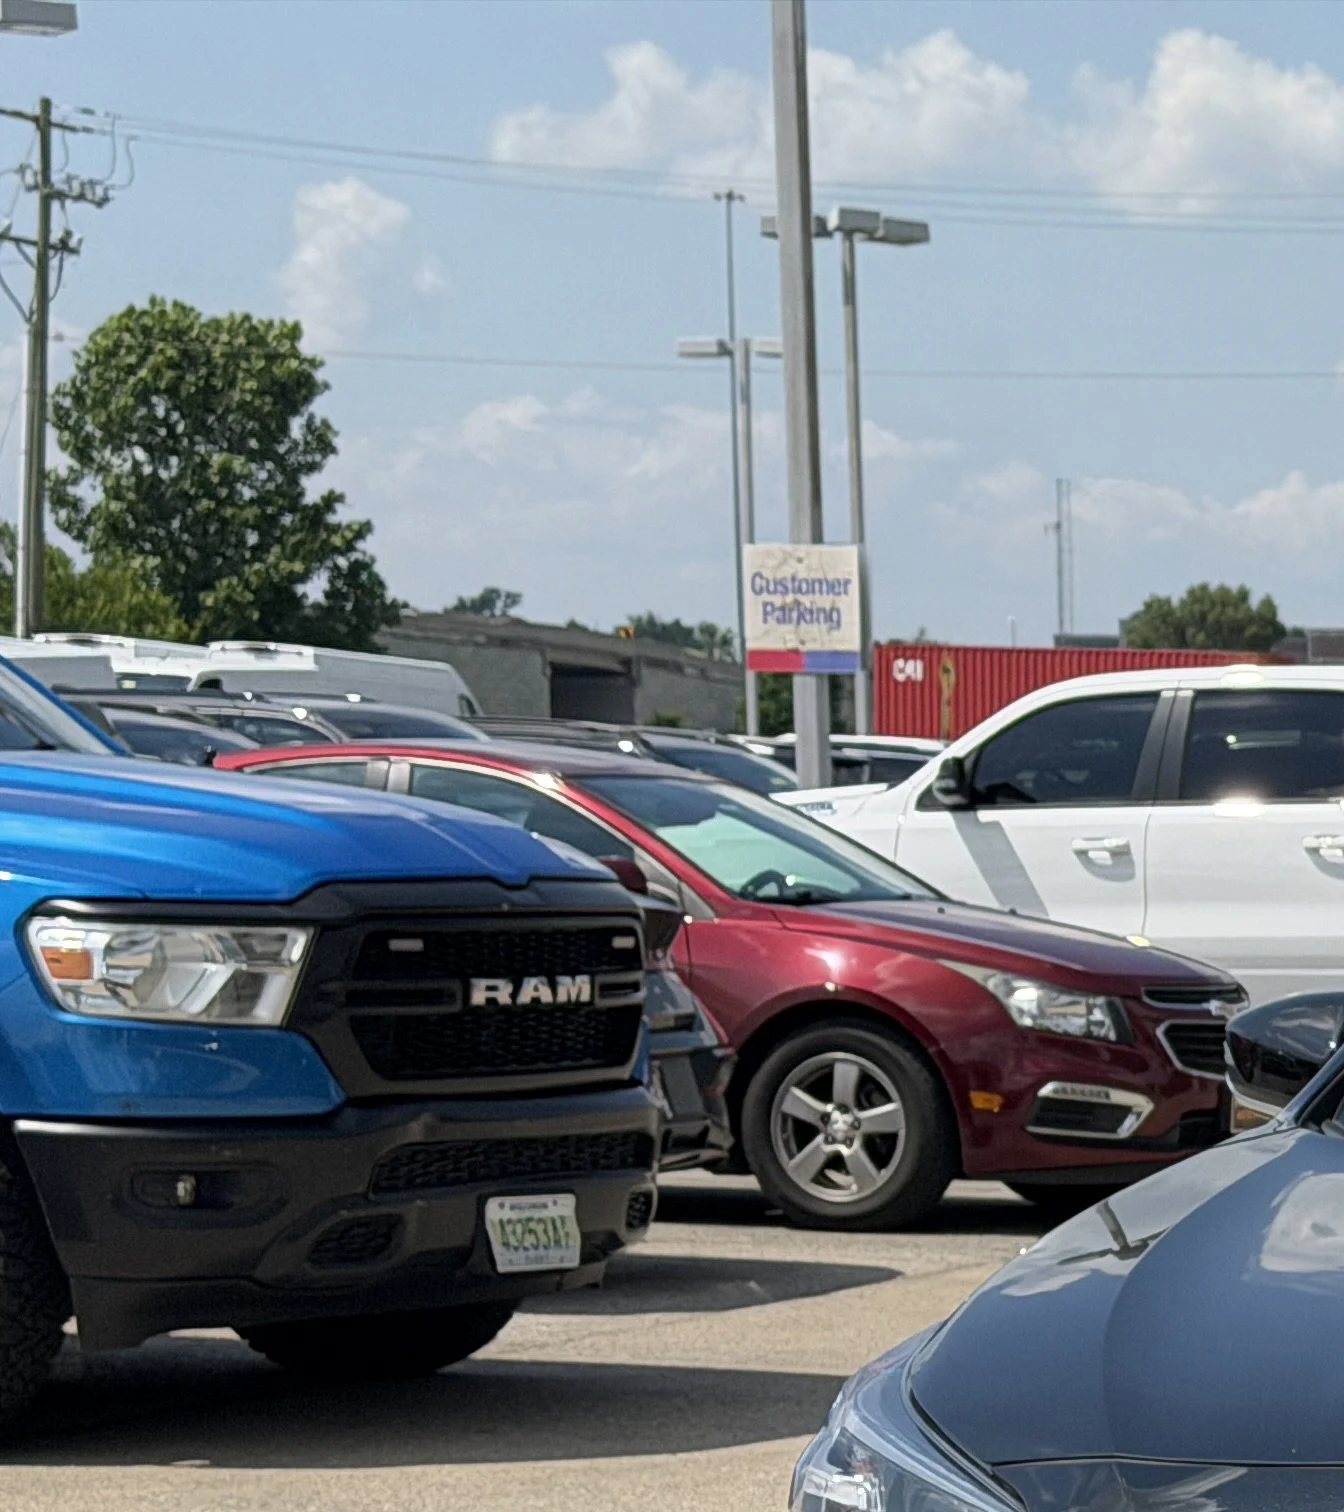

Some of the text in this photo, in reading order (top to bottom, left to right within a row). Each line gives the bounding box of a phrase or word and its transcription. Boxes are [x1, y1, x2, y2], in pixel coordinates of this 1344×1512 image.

[750, 571, 853, 597] Customer
[761, 601, 842, 630] Parking
[469, 974, 592, 1007] RAM
